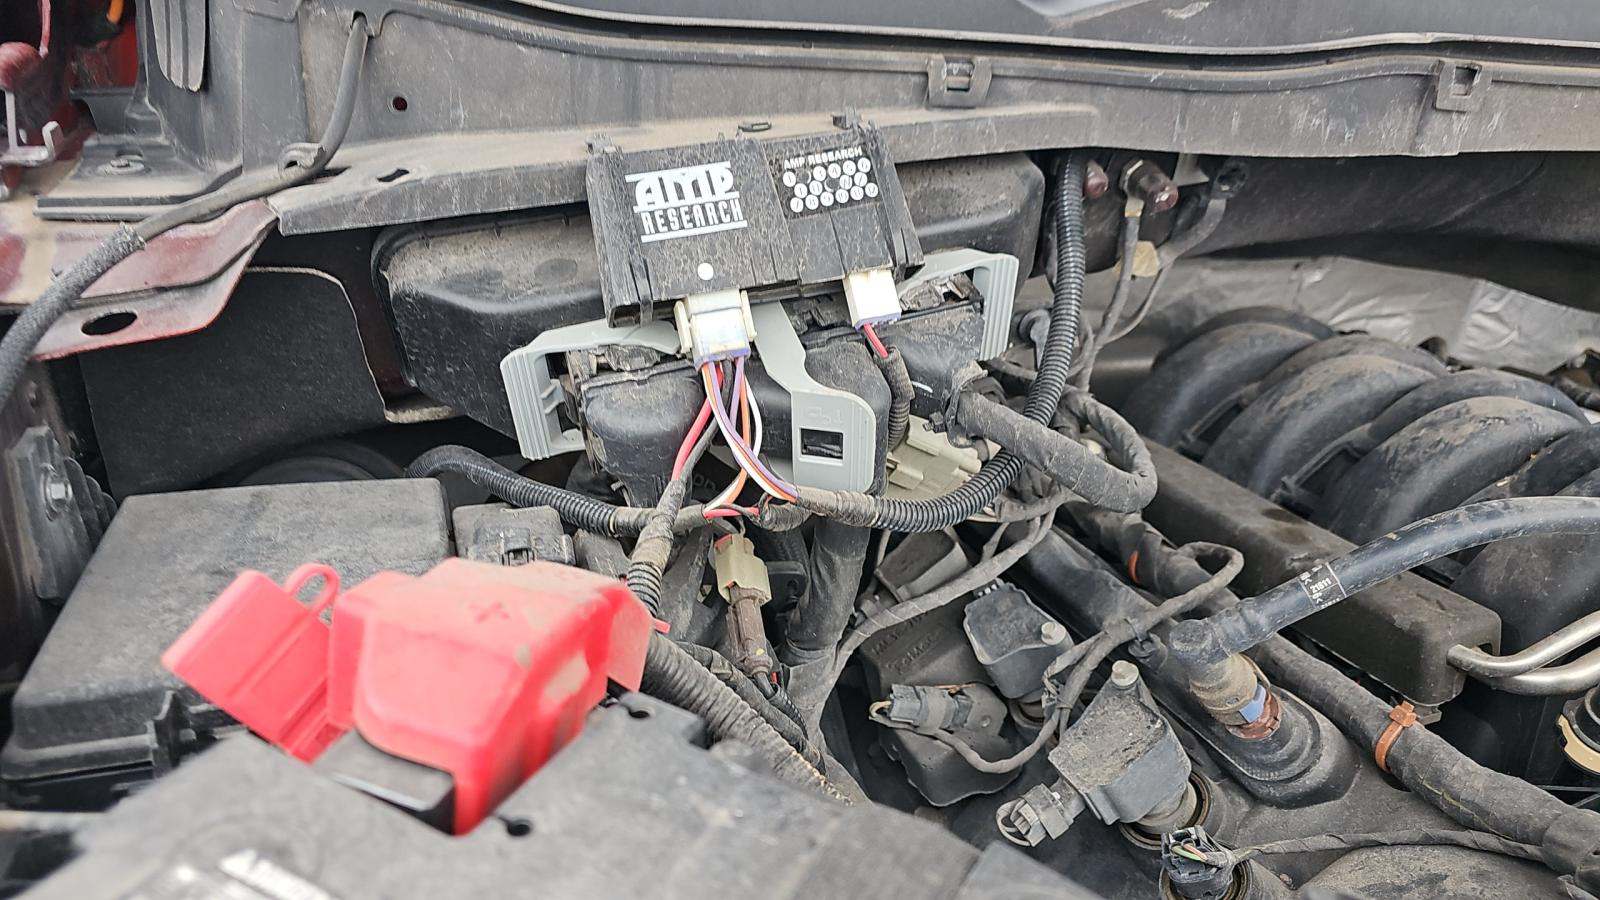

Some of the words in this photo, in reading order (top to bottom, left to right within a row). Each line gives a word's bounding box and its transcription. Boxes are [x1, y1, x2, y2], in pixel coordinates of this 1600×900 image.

[784, 157, 805, 170] AMP
[807, 146, 863, 166] RESEARCH
[626, 161, 739, 213] AMP
[640, 198, 744, 235] RESEARCH
